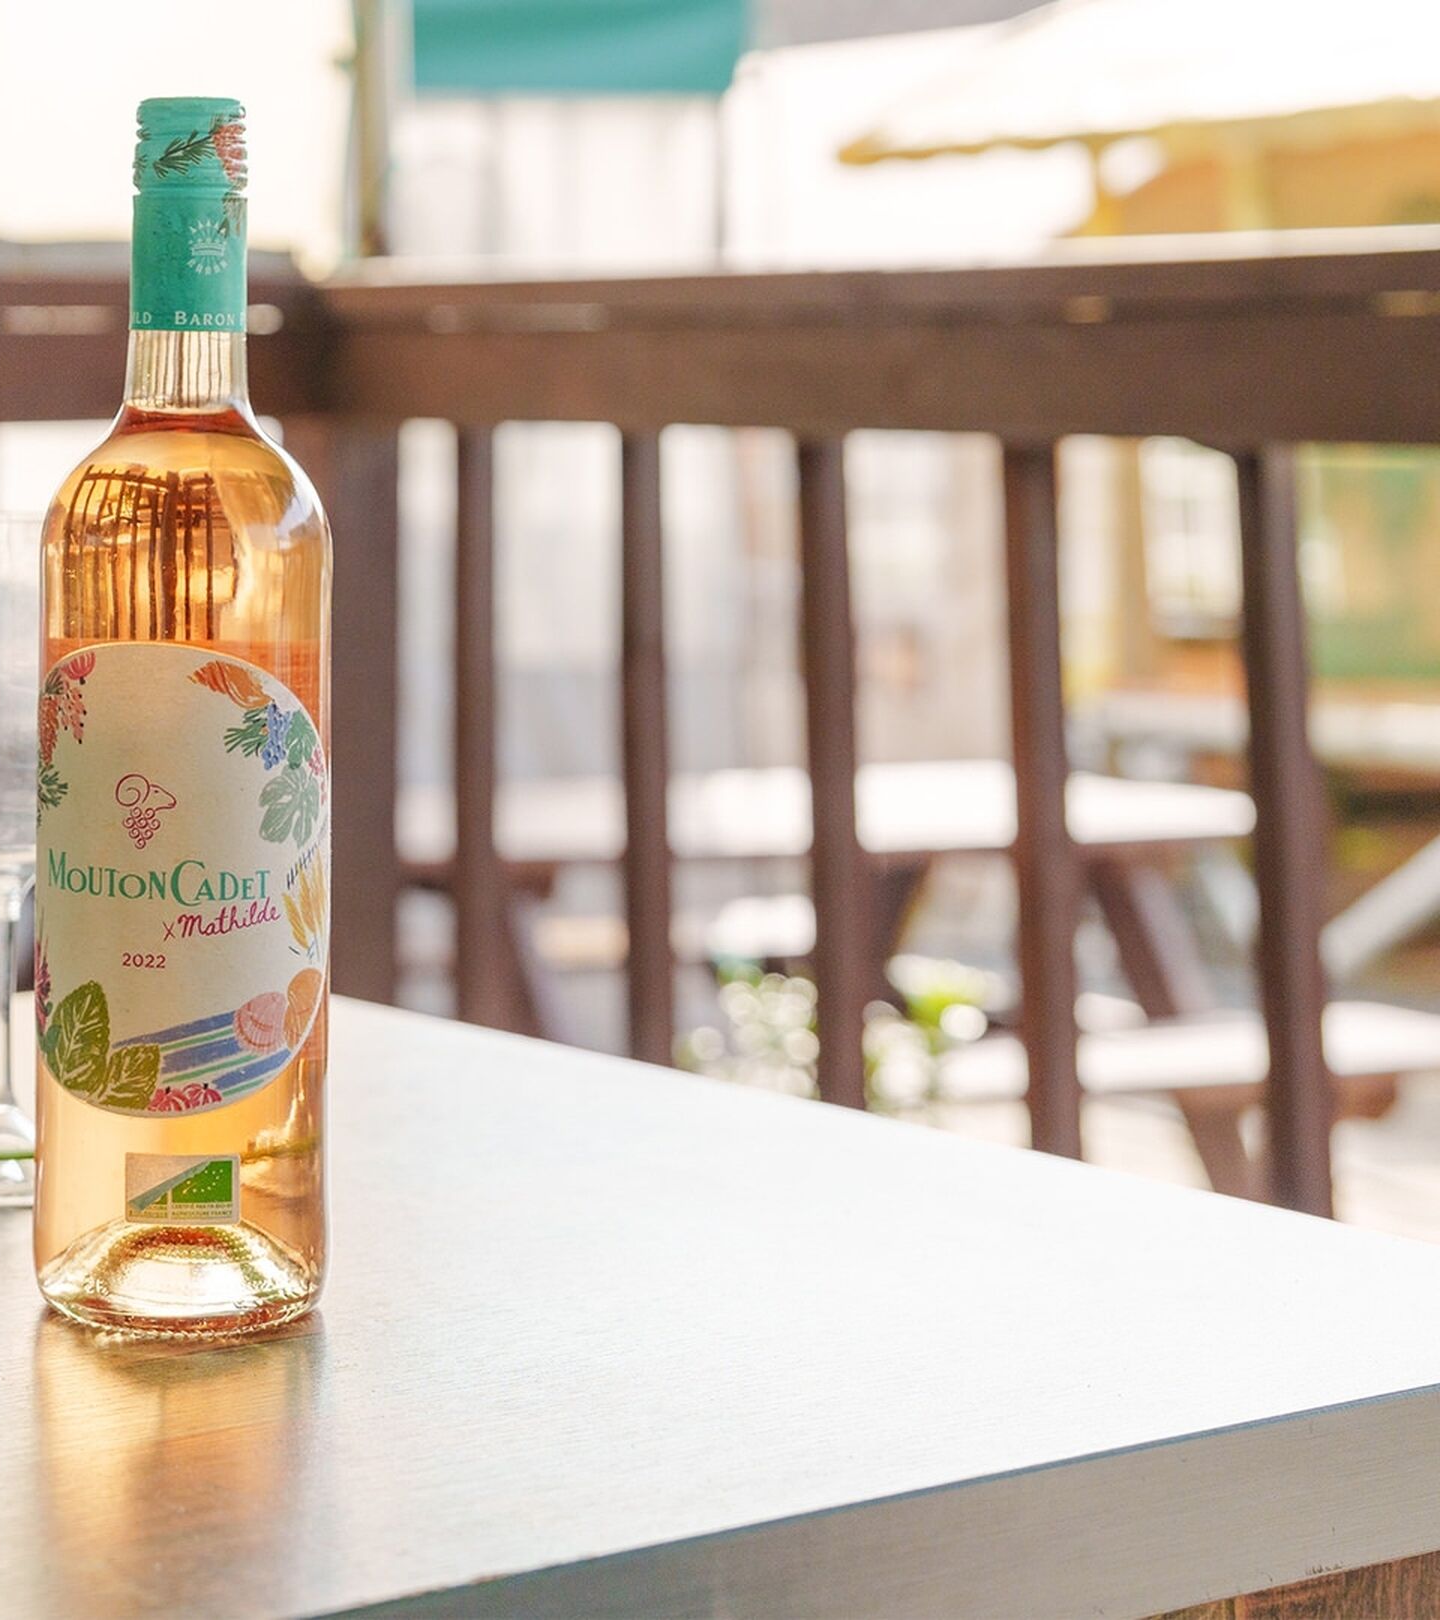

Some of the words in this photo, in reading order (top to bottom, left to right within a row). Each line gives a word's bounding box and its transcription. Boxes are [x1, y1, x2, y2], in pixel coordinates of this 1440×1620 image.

[175, 310, 235, 326] BARON
[48, 848, 167, 900] MOUTON
[170, 860, 270, 907] CADET
[177, 897, 281, 939] Mathilde
[121, 952, 166, 969] 2022
